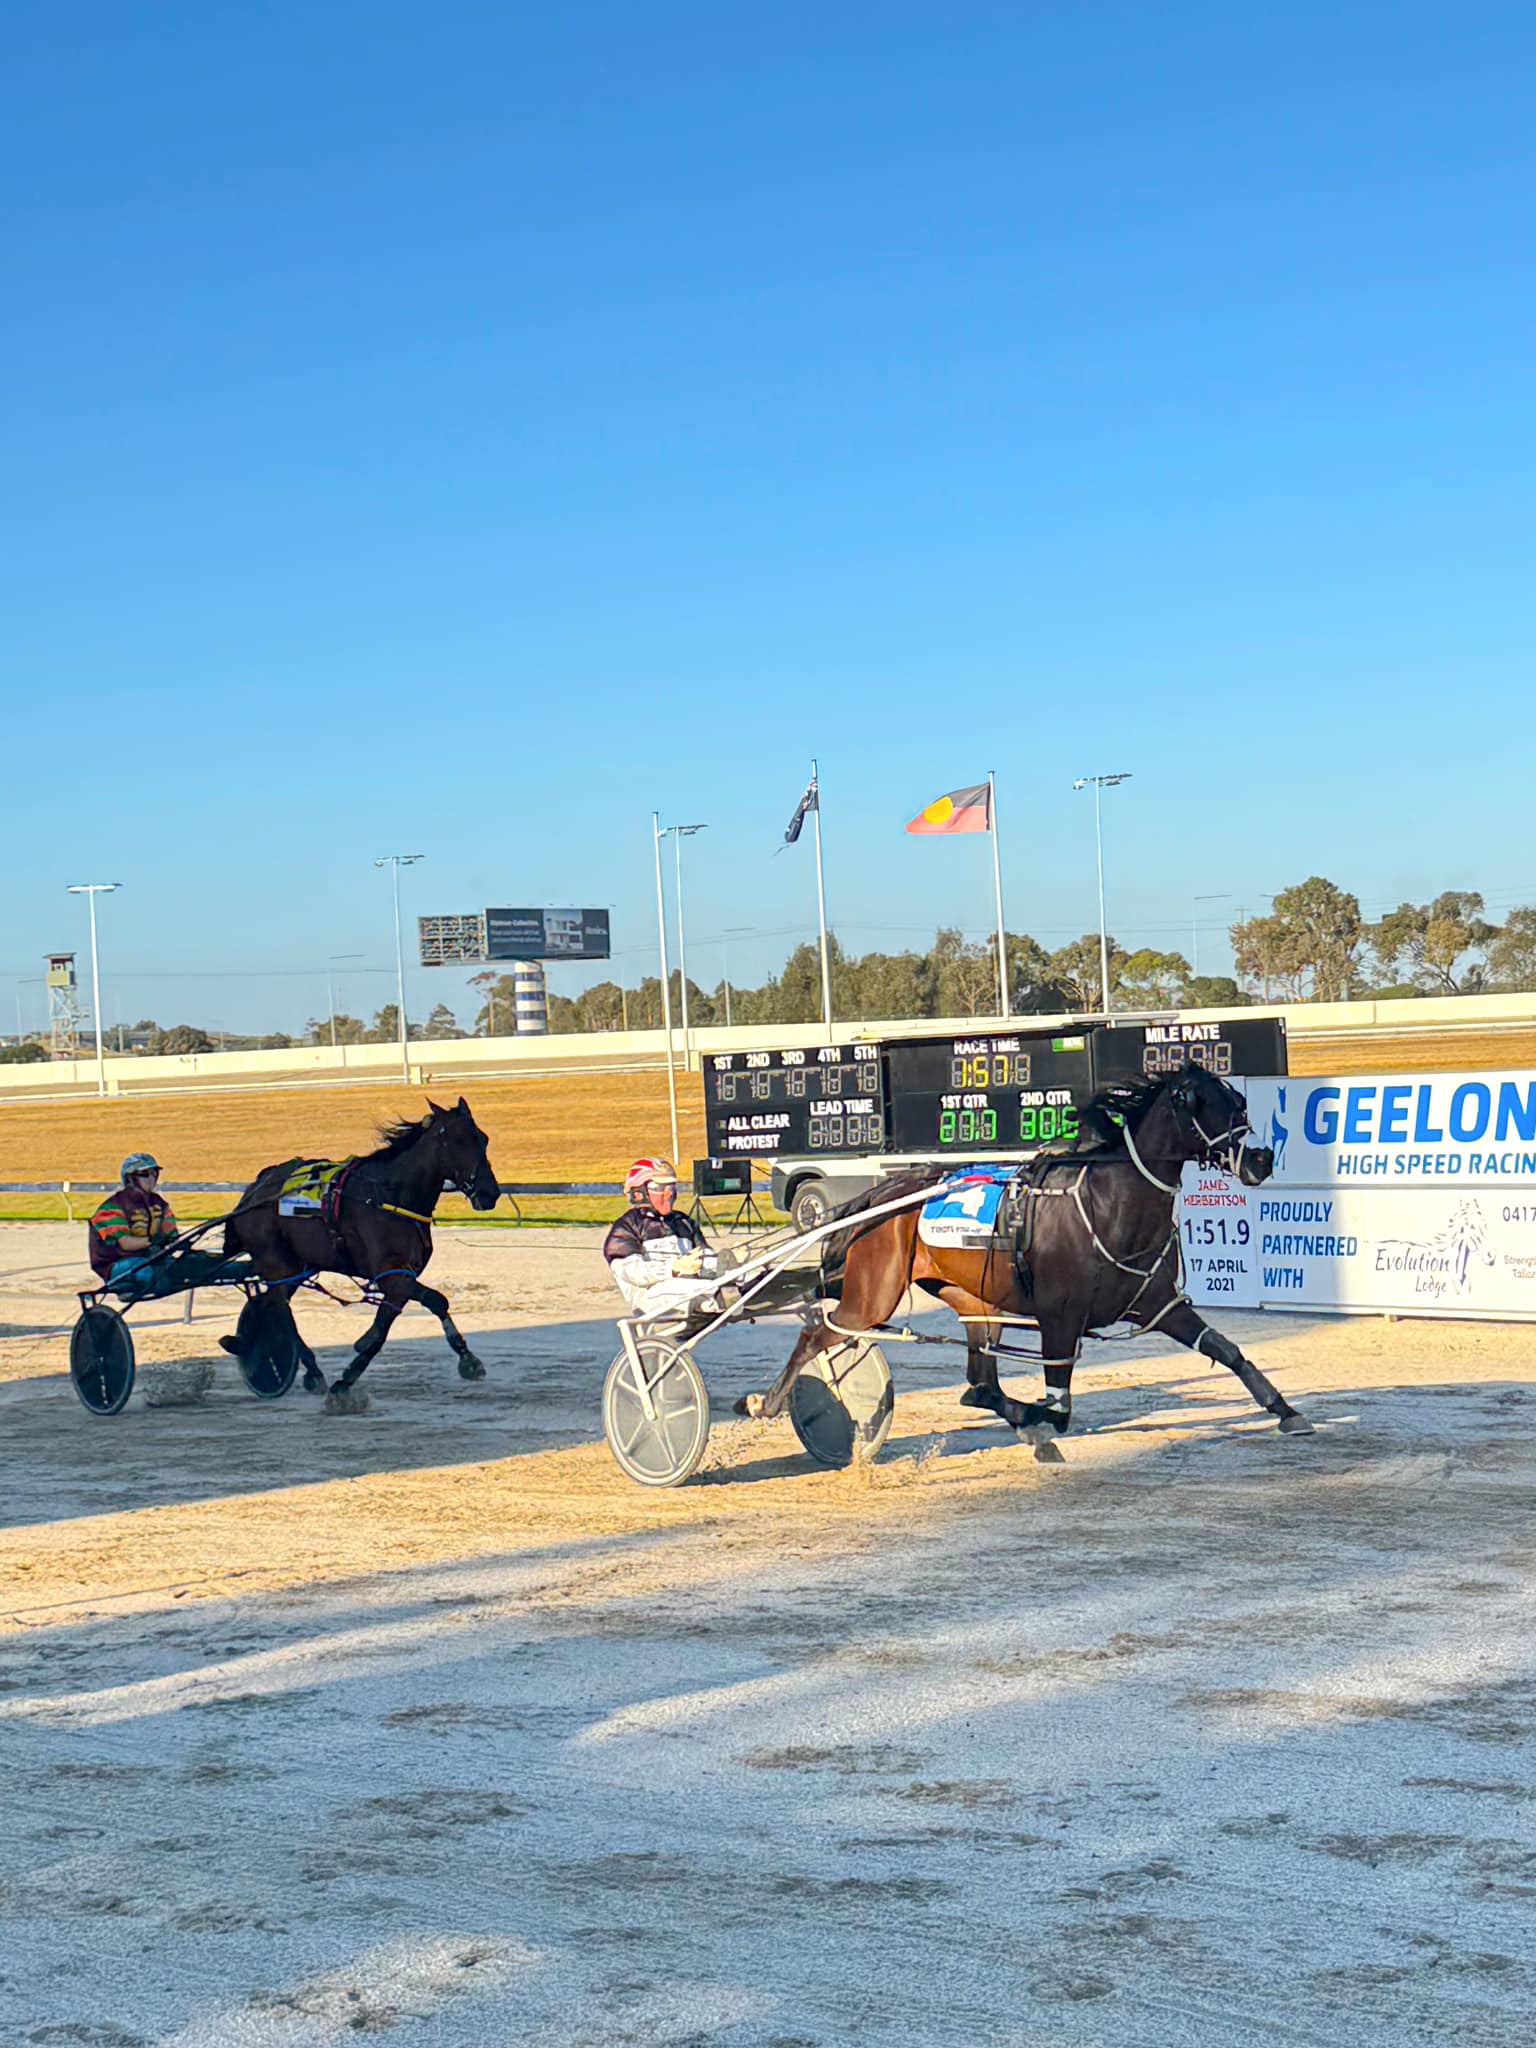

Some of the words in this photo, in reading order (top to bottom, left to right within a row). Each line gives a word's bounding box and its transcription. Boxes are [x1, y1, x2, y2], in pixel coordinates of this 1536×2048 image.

[1145, 1026, 1179, 1043] MILE
[1182, 1024, 1220, 1041] RATE
[954, 1040, 988, 1054] RACE
[992, 1037, 1020, 1052] TIME
[713, 1056, 733, 1070] 1ST
[746, 1053, 770, 1067] 2ND
[781, 1051, 805, 1065] 3RD
[817, 1048, 841, 1062] 4TH
[854, 1046, 878, 1060] 5TH
[940, 1095, 962, 1109] 1ST
[963, 1094, 988, 1108] QTR
[1020, 1092, 1044, 1106] 2ND
[1046, 1090, 1071, 1104] QTR
[810, 1100, 843, 1115] LEAD
[844, 1099, 873, 1113] TIME
[728, 1116, 750, 1131] ALL
[751, 1114, 790, 1129] CLEAR
[728, 1134, 780, 1150] PROTEST
[1337, 1154, 1388, 1175] HIGH
[1394, 1153, 1461, 1174] SPEED
[1198, 1179, 1229, 1191] JAMES
[1184, 1194, 1247, 1206] HERBERTSON
[1260, 1201, 1333, 1223] PROUDLY
[1184, 1218, 1250, 1245] 1:51.9
[1262, 1234, 1358, 1256] PARTNERED
[1190, 1258, 1203, 1272] 17
[1208, 1259, 1248, 1273] APRIL
[1375, 1247, 1450, 1272] Evolution
[1206, 1278, 1235, 1291] 2021
[1263, 1267, 1304, 1288] WITH
[1415, 1275, 1447, 1298] Lodge
